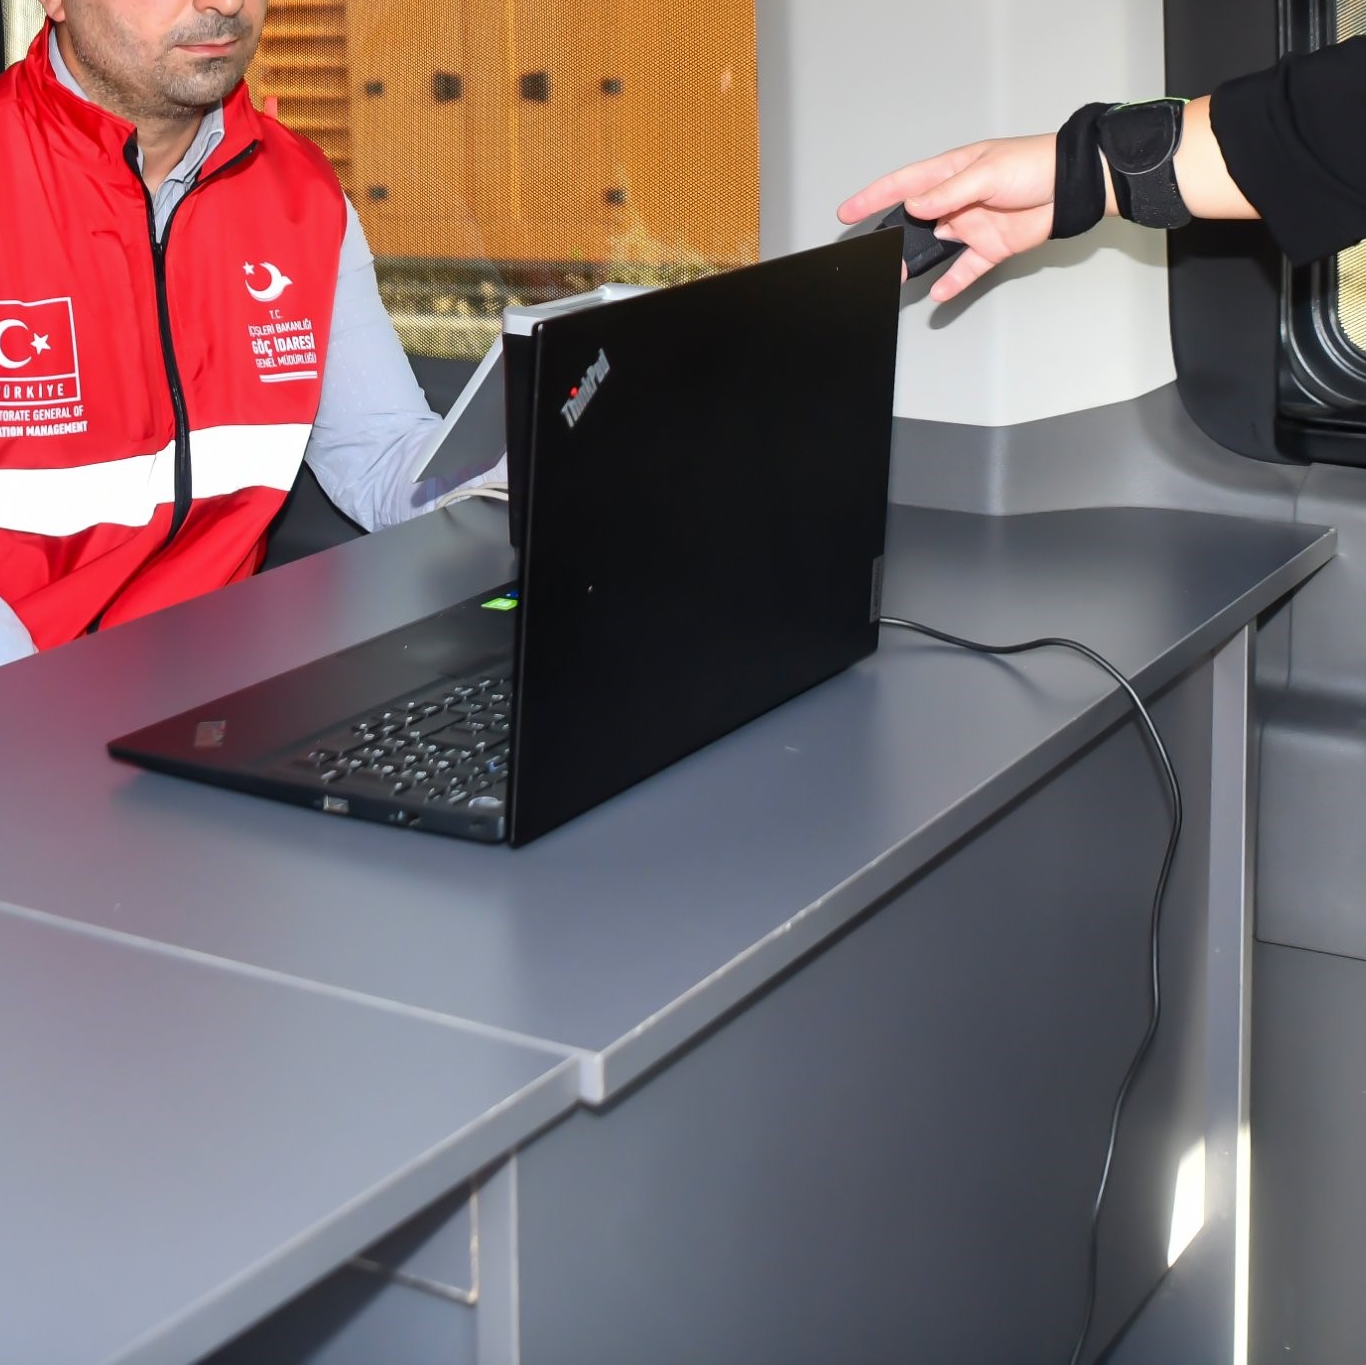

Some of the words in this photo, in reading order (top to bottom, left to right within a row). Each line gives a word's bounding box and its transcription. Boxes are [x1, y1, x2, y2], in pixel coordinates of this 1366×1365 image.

[269, 309, 283, 319] T.C.
[275, 318, 312, 333] BAKANLIĞI
[252, 338, 273, 356] GÖÇ
[273, 332, 315, 352] İDARESİ
[255, 357, 277, 368] GENEL
[277, 352, 317, 366] MÜDÜRLÜĞÜ
[560, 347, 610, 428] ThinkPad
[32, 407, 71, 421] GENERAL
[73, 405, 84, 416] OF
[25, 420, 88, 437] MANAGEMENT
